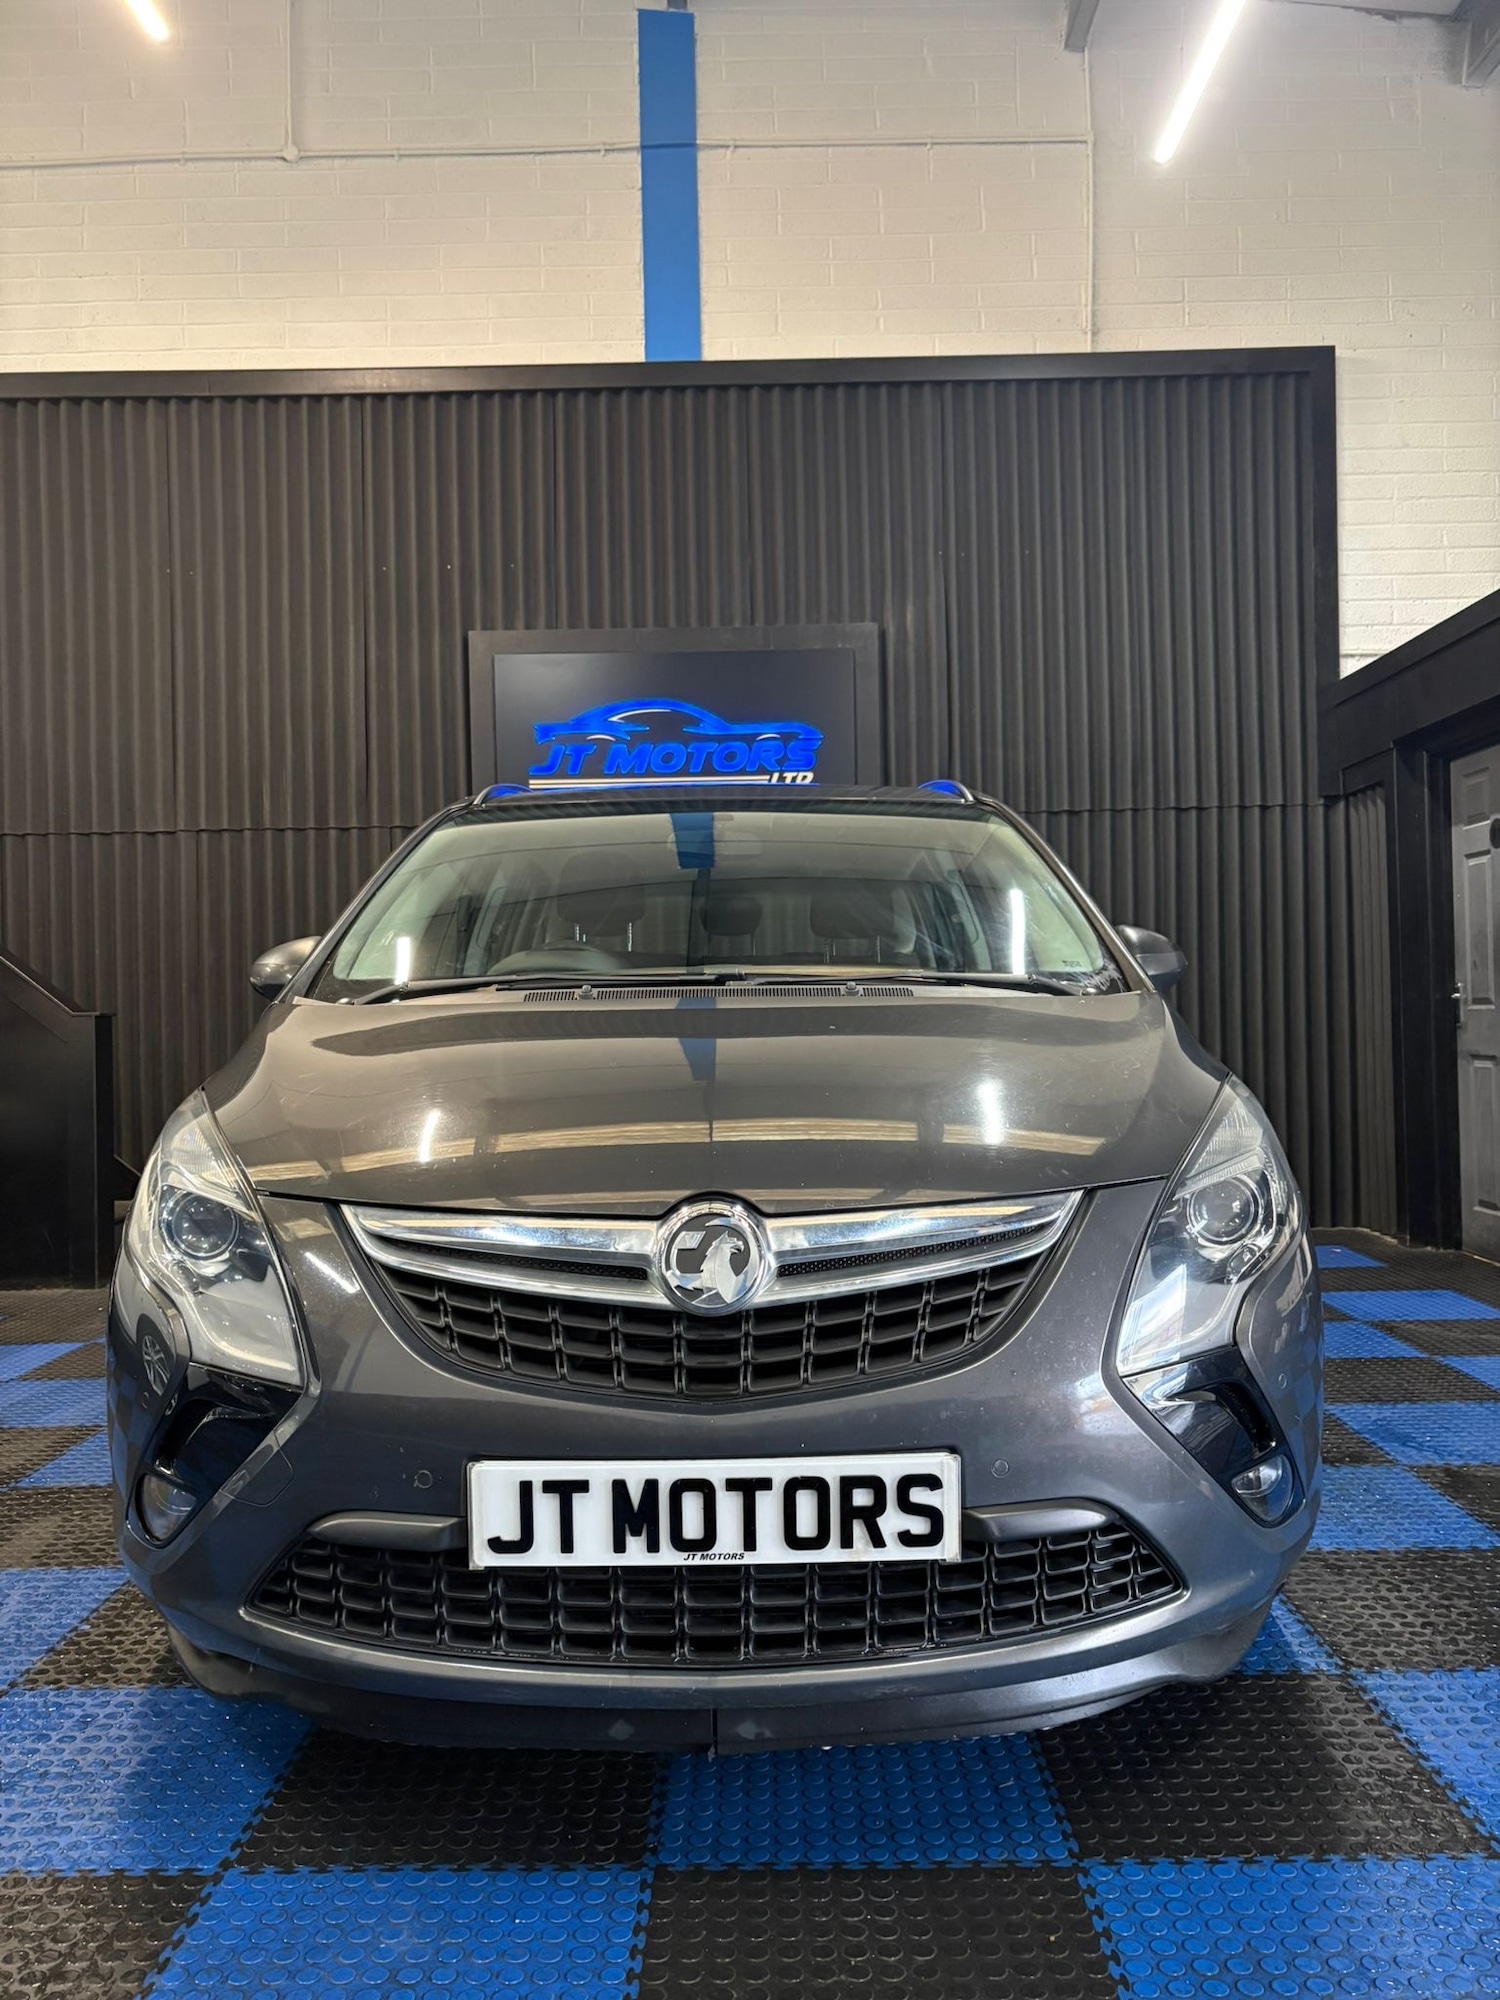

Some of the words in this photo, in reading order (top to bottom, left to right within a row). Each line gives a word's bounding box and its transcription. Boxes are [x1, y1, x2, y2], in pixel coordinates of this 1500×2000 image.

[528, 743, 597, 776] JT
[603, 739, 821, 774] MOTORS
[486, 1479, 590, 1555] JT
[611, 1473, 945, 1554] MOTORS
[683, 1553, 698, 1561] JT
[699, 1552, 745, 1561] MOTORS
